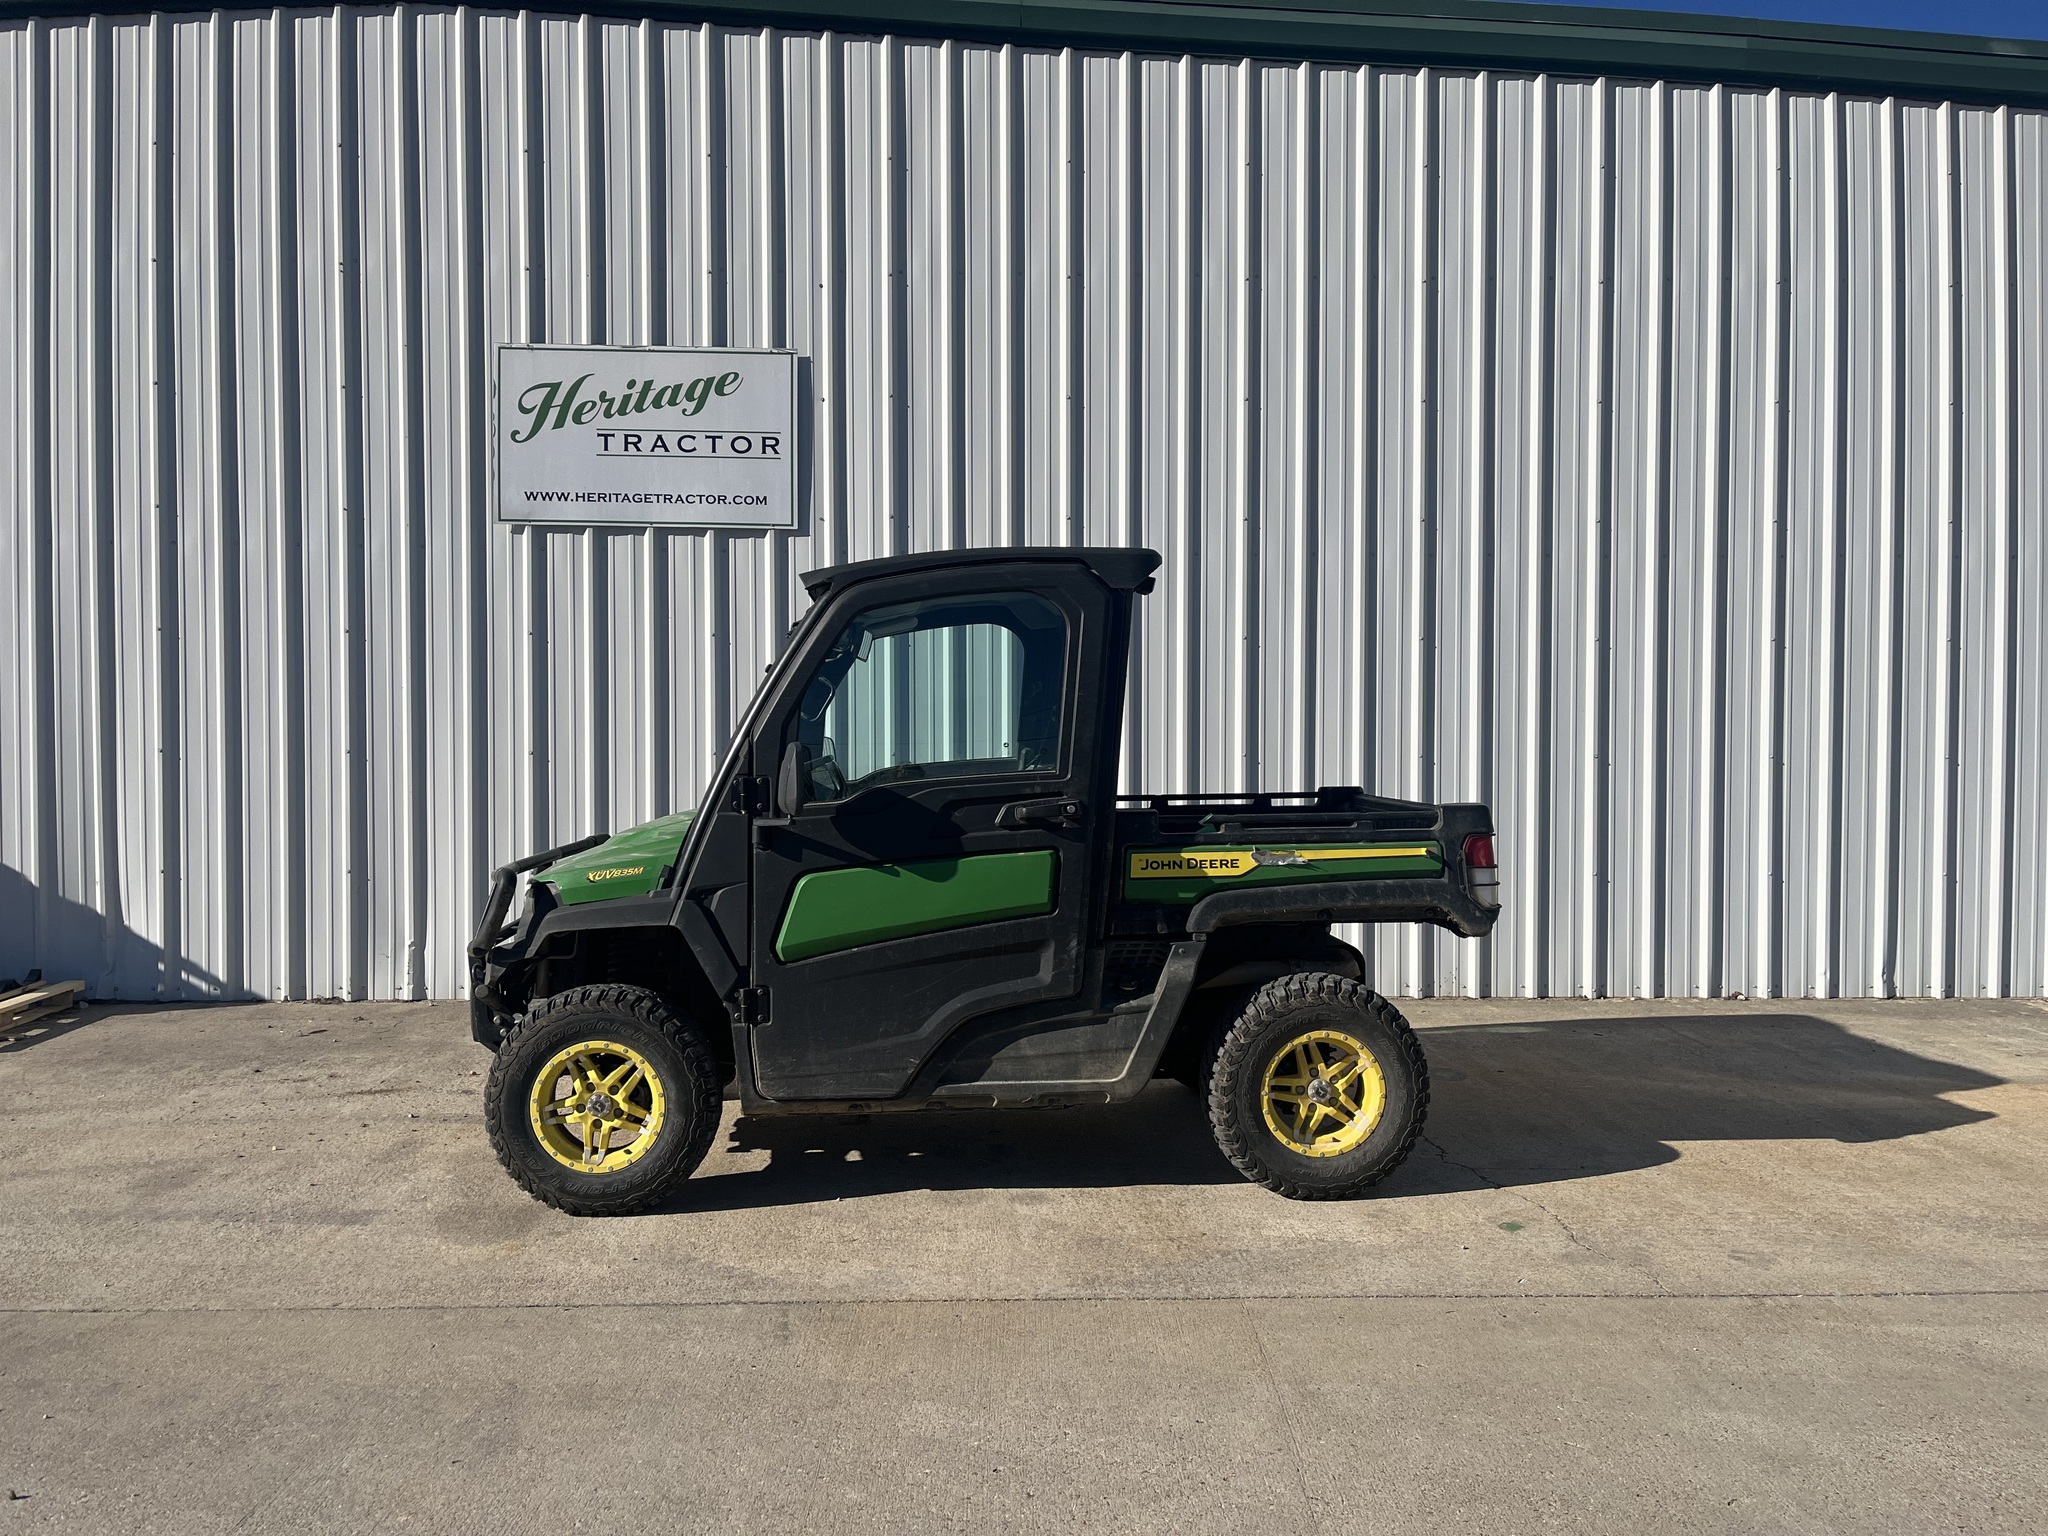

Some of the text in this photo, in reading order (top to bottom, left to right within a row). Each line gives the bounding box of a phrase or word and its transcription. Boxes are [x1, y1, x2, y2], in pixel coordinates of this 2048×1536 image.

[510, 371, 744, 443] Heritage
[596, 432, 781, 455] TRACTOR
[524, 491, 768, 506] WWW.HERITAGETRACTOR.COM
[1140, 857, 1240, 870] JOHN DEERE
[587, 866, 645, 882] XUV835M
